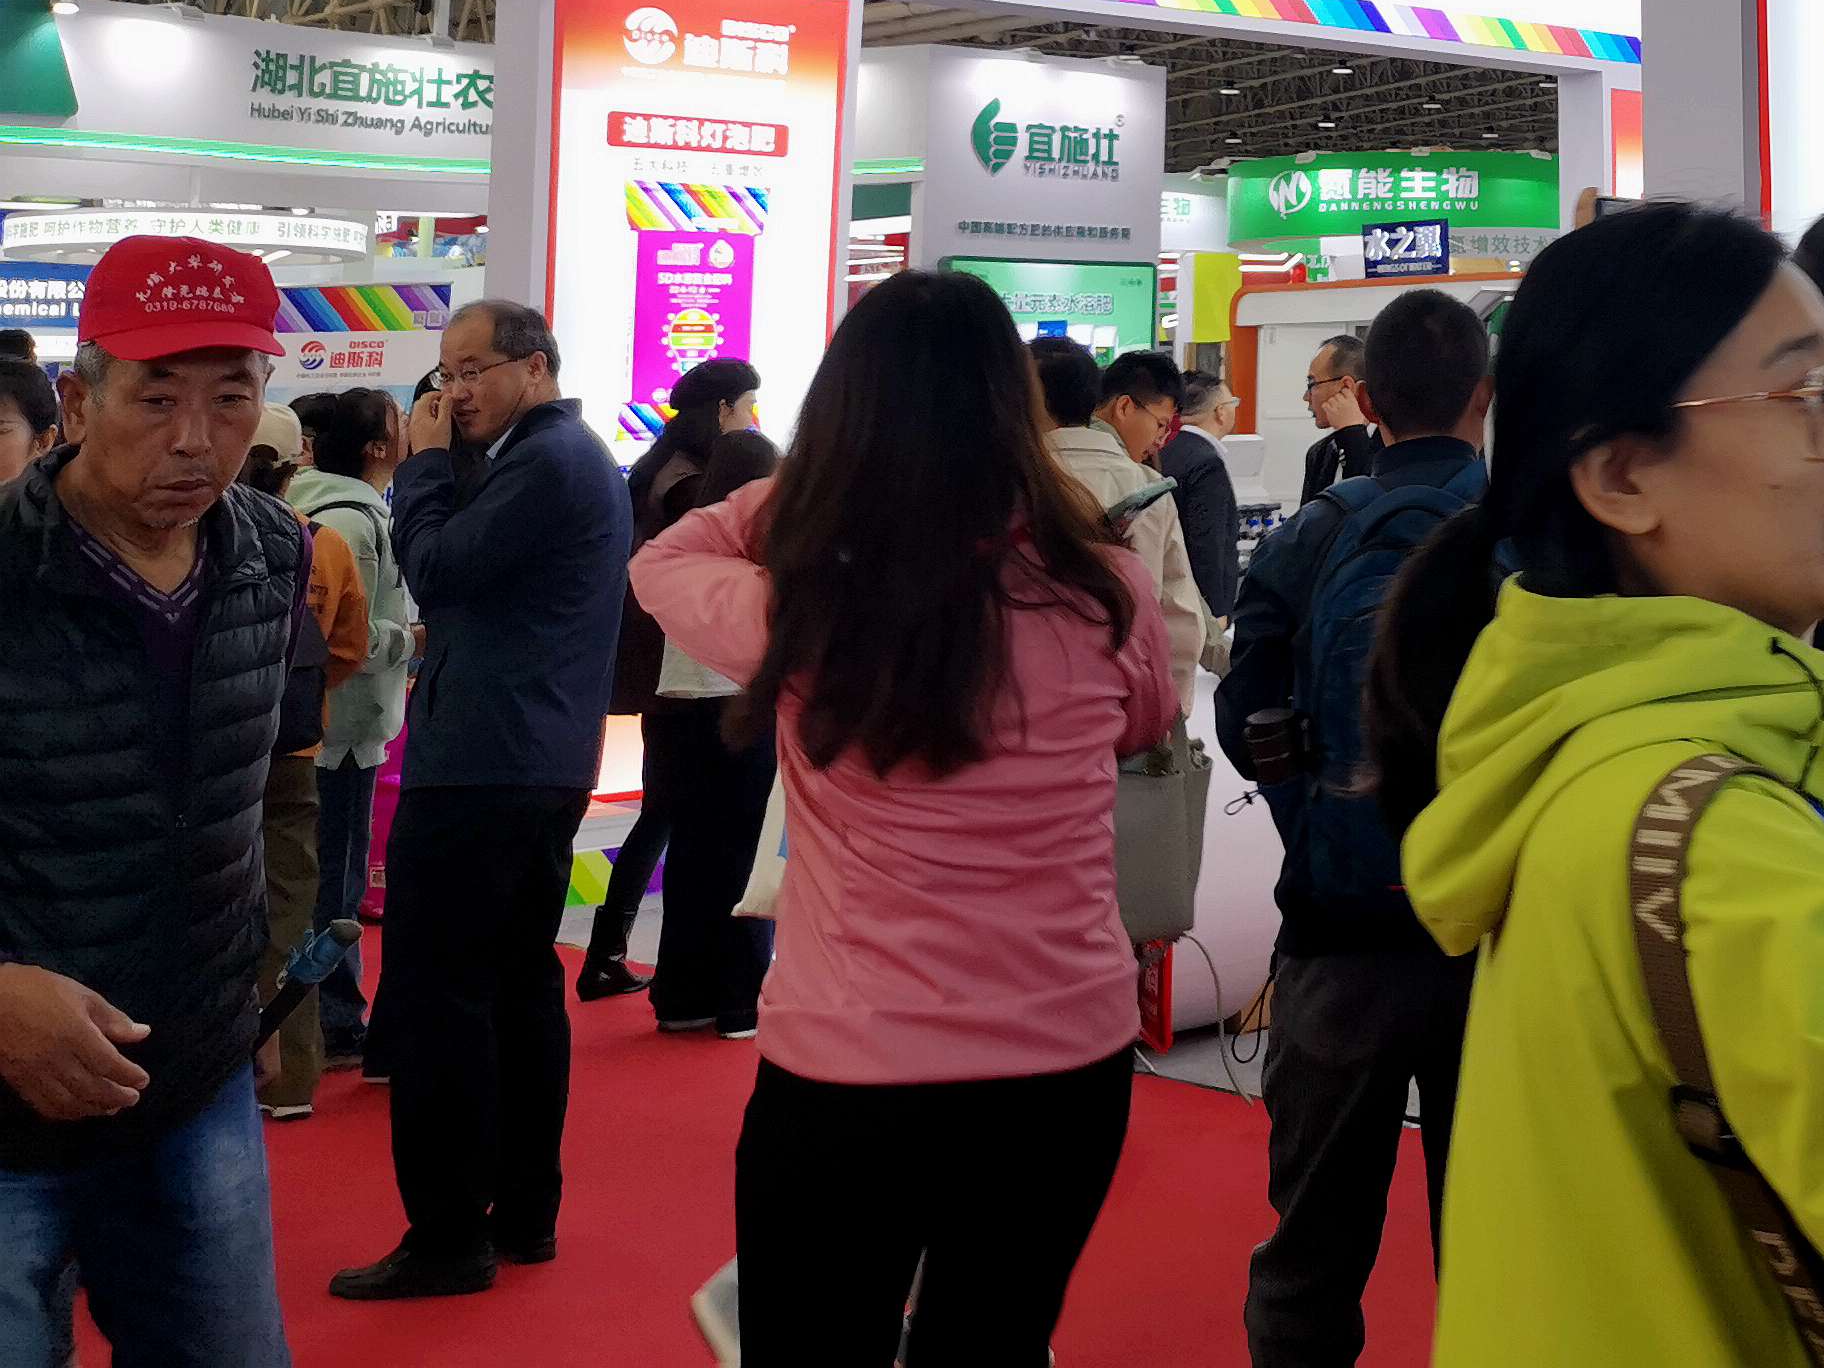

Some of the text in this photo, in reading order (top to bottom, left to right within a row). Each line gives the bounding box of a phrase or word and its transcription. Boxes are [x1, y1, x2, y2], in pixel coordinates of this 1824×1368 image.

[250, 101, 294, 122] Hubei
[299, 105, 312, 125] Yi
[314, 107, 340, 126] Shi
[341, 111, 405, 136] Zhuang
[1024, 122, 1120, 167] 宜施壮
[349, 340, 385, 349] DISCO
[329, 350, 384, 369] 迪斯科
